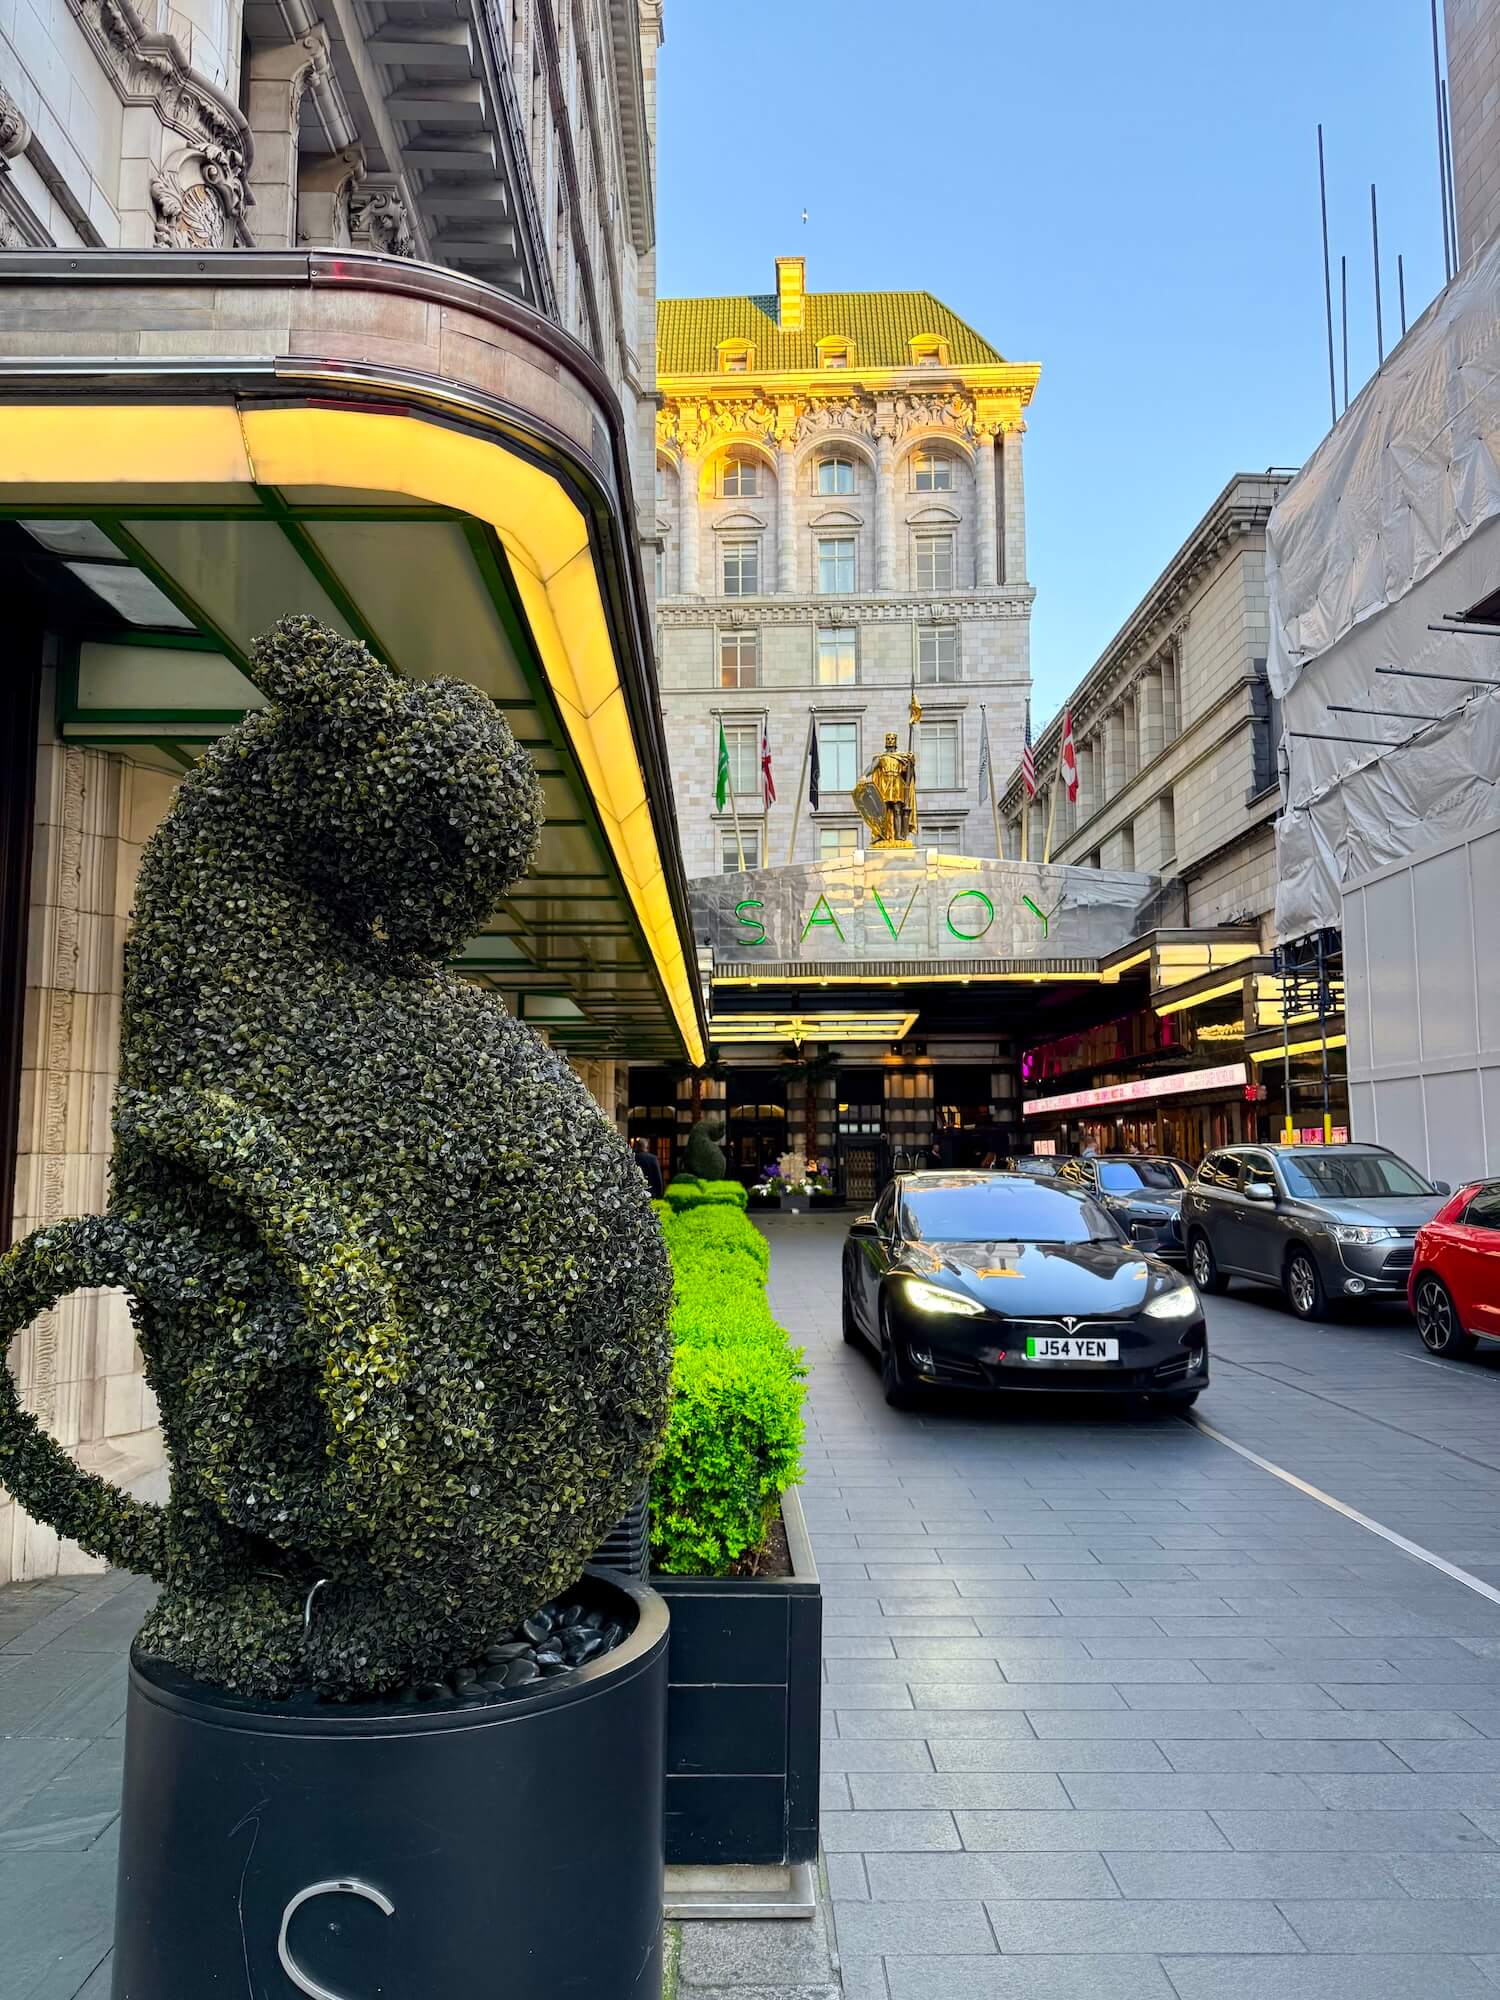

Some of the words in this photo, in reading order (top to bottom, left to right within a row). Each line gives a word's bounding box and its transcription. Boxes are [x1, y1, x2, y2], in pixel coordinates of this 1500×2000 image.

[735, 885, 1067, 945] SAVOY
[1040, 1340, 1070, 1356] J54
[1075, 1341, 1106, 1357] YEN
